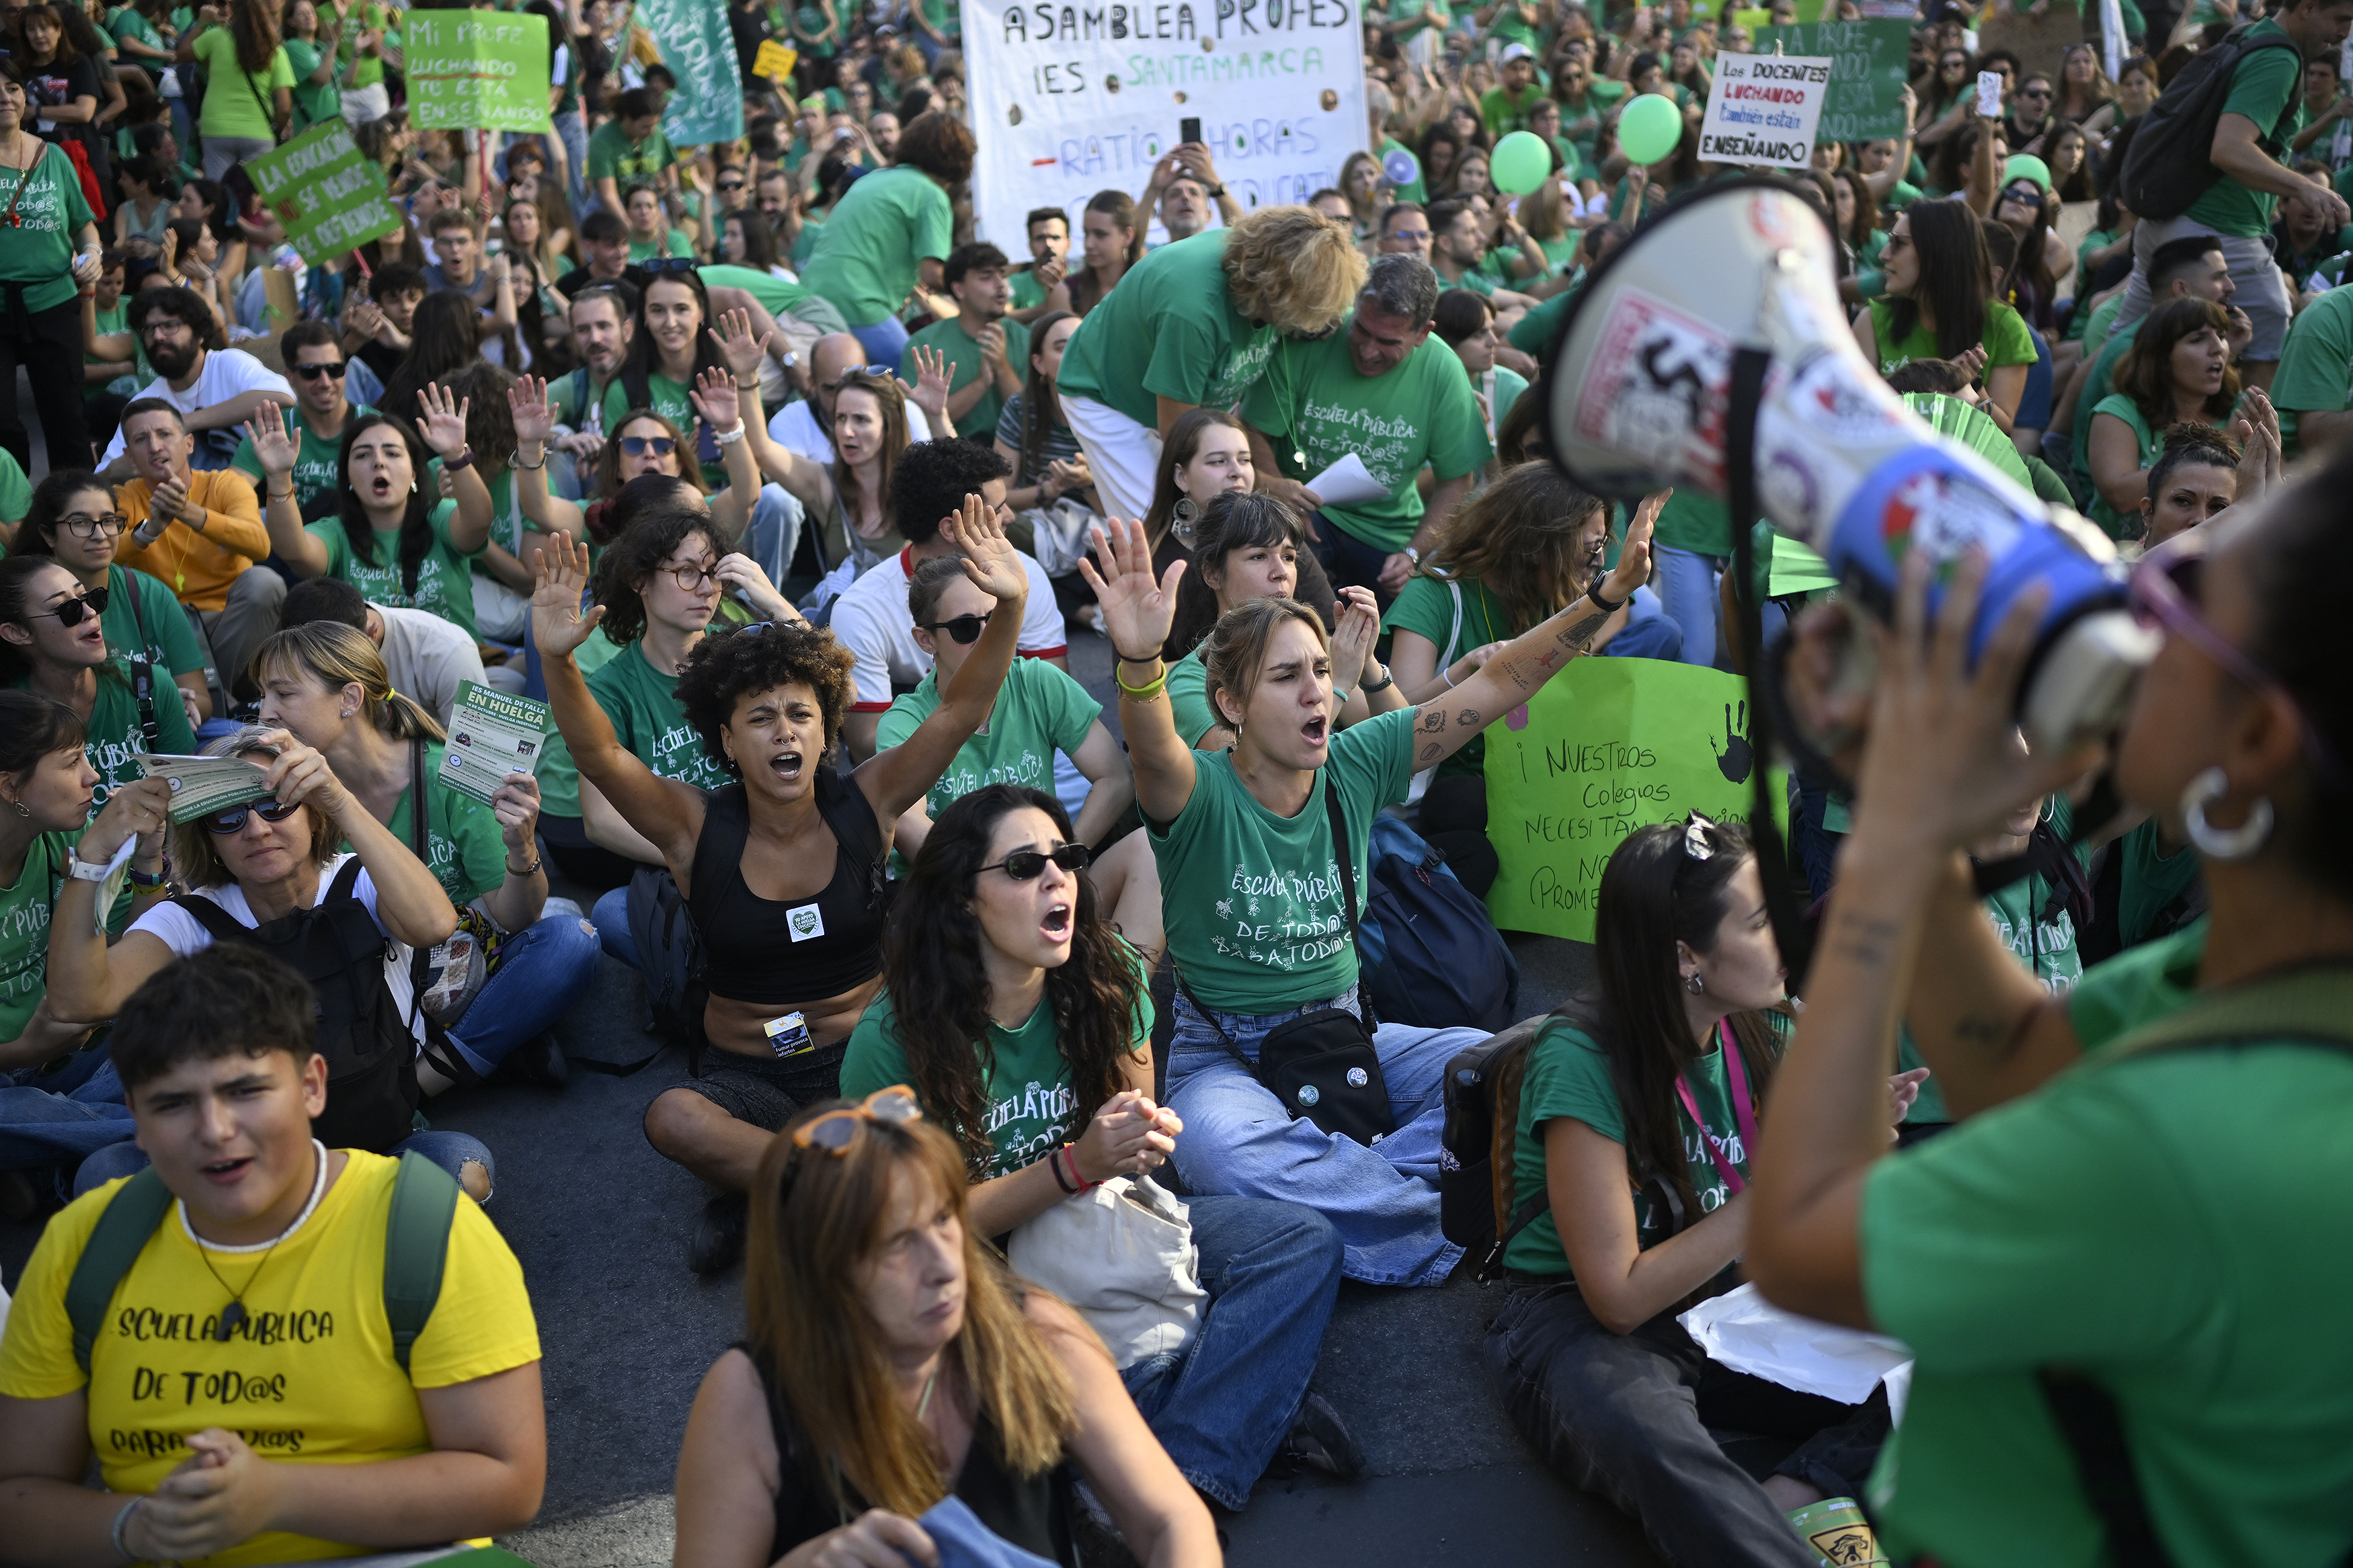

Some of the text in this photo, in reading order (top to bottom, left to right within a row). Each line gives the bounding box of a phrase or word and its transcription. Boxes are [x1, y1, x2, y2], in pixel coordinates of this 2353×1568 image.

[457, 21, 524, 45] PROFE
[1004, 3, 1195, 43] ASAMBLEA
[1816, 21, 1870, 52] PROFE
[409, 57, 517, 76] LUCHANDO
[1034, 46, 1324, 95] IES SANTAMARCA
[1752, 62, 1829, 83] DOCENTES
[1724, 82, 1805, 104] LUCHANDO
[1207, 117, 1322, 159] HORAS
[1702, 131, 1806, 162] ENSEÑANDO
[257, 165, 288, 194] LA
[298, 185, 321, 213] SE
[320, 162, 372, 202] VENDE
[296, 233, 319, 259] SE
[1304, 403, 1358, 427] ESCUELA
[1308, 436, 1331, 450] DE
[1339, 440, 1397, 462] TOD@S
[467, 691, 543, 726] EN HUELGA
[472, 685, 483, 693] IES
[483, 690, 512, 704] MANUEL
[524, 704, 545, 714] FALLA
[464, 723, 485, 733] PROFESORADO
[477, 706, 496, 716] OCTUBRE
[499, 714, 515, 723] HUELGA
[516, 720, 540, 730] INDEFINIDA
[467, 750, 486, 761] CONDICIONES
[493, 747, 514, 757] ESPECIALISTAS
[1546, 739, 1657, 778] NUESTROS
[171, 787, 195, 799] QUIPARACIÓN
[440, 776, 454, 784] PORQUE
[461, 783, 481, 796] EDUCACIÓN
[1583, 779, 1671, 817] Colegios
[173, 806, 194, 816] PORQUE
[200, 794, 227, 805] EDUCACIÓN
[228, 789, 247, 797] PÚBLICA
[212, 799, 232, 809] EDUCACIÓN
[797, 921, 815, 930] EDUCATIVA
[1236, 921, 1271, 941] DE
[775, 1037, 808, 1053] Fumar provoca
[1371, 1132, 1384, 1144] NIKE
[132, 1366, 286, 1405] DE TOD@S
